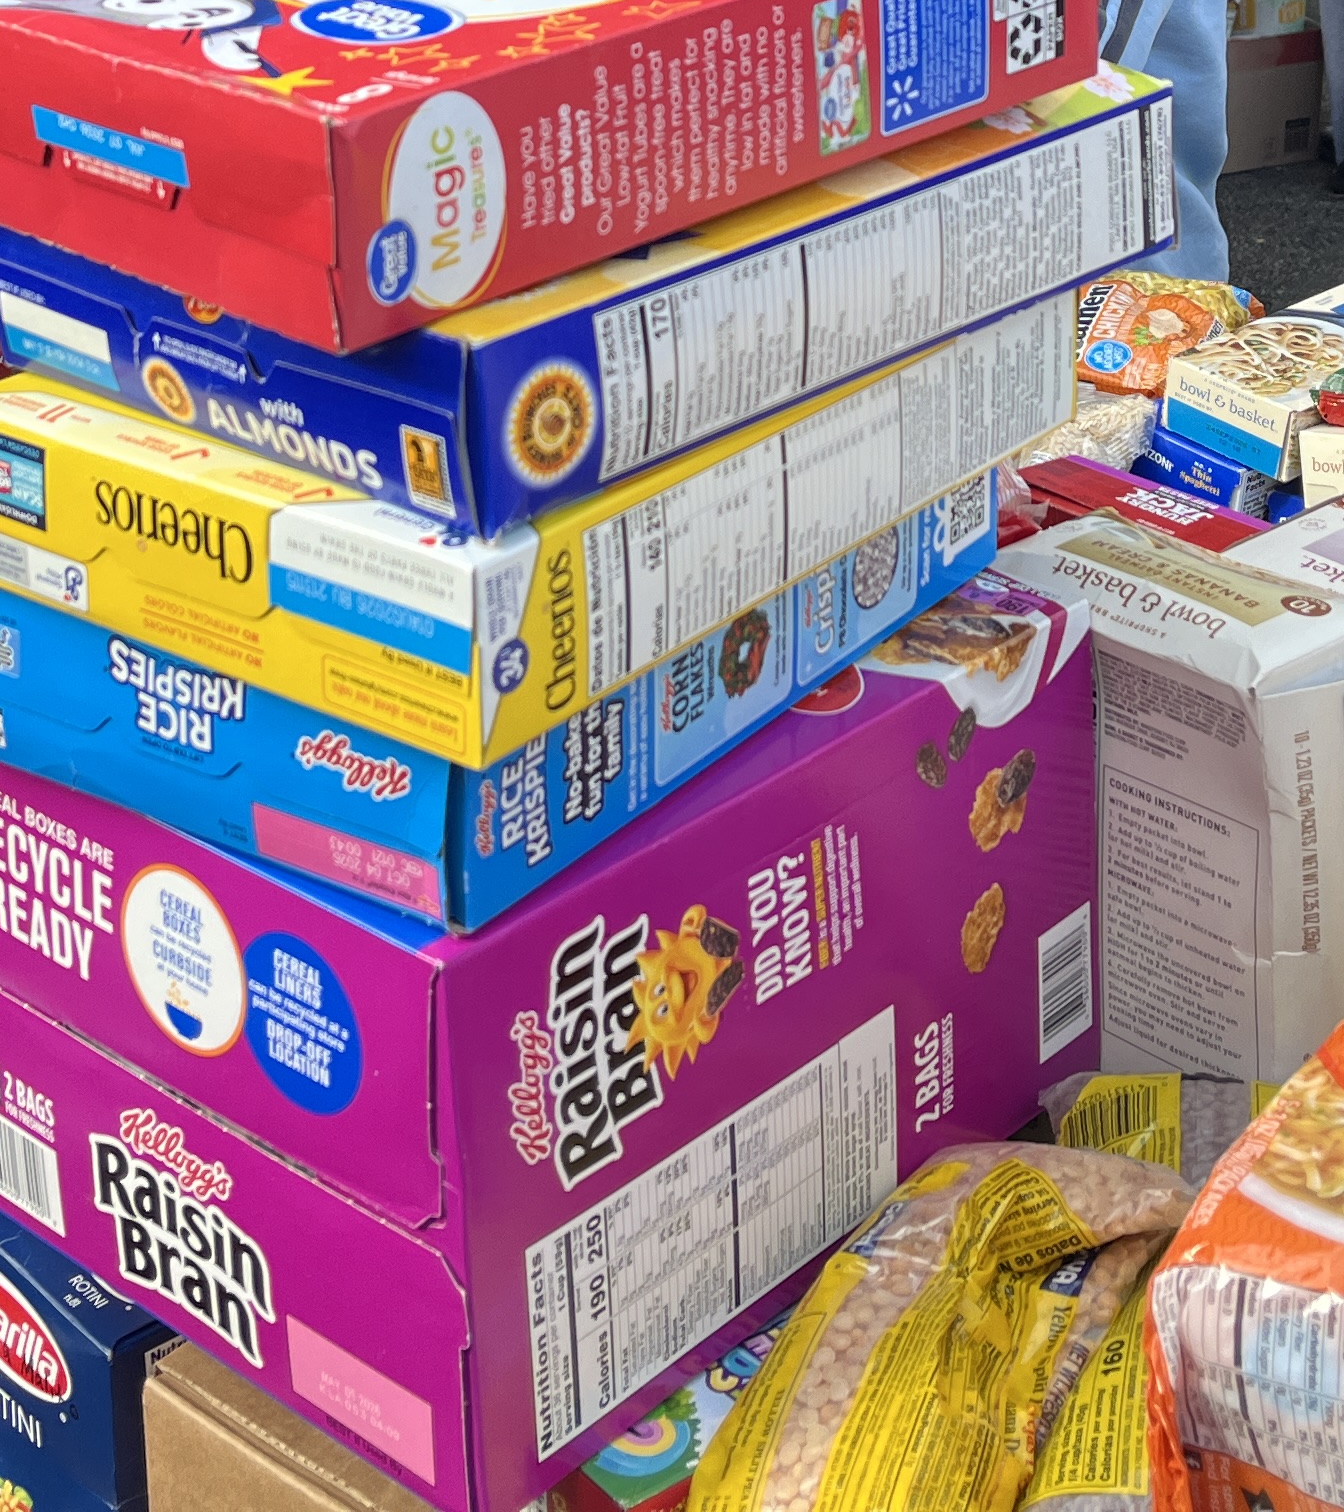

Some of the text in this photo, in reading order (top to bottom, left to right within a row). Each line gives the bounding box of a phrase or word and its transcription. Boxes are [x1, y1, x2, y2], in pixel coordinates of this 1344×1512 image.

[429, 125, 466, 273] Magic
[574, 107, 595, 208] product?
[207, 398, 386, 491] ALMONDS
[258, 396, 307, 427] with
[1178, 375, 1278, 433] bowl & basket
[94, 478, 254, 585] Cheerios
[1127, 486, 1216, 522] JACK
[545, 548, 575, 712] Cheerios
[109, 639, 246, 722] KRISPIES
[671, 656, 691, 735] CORN
[137, 692, 214, 754] RICE
[299, 730, 411, 801] Kellogg's
[501, 758, 525, 850] RICE
[1108, 776, 1232, 838] COOKING INSTRUCTIONS:
[23, 806, 78, 850] BOXES
[79, 838, 115, 872] ARE
[158, 888, 205, 926] CEREAL
[779, 852, 812, 988] KNOW?
[1107, 867, 1155, 898] MICROWAVE:
[151, 938, 214, 987] CURBSIDE
[162, 910, 202, 946] BOXES
[748, 868, 776, 1006] DID YOU
[547, 914, 622, 1191] Raisin
[602, 912, 664, 1125] Bran
[3, 1071, 56, 1129] 2 BAGS
[509, 1010, 554, 1166] Kellogg's
[119, 1107, 233, 1201] Kellogg's
[91, 1134, 275, 1323] Raisin
[586, 1213, 605, 1264] 250
[67, 1274, 109, 1310] ROTINI
[120, 1218, 265, 1368] Bran
[530, 1251, 555, 1454] Nutrition Facts
[589, 1272, 615, 1410] Calories 190
[1100, 1339, 1126, 1378] 160
